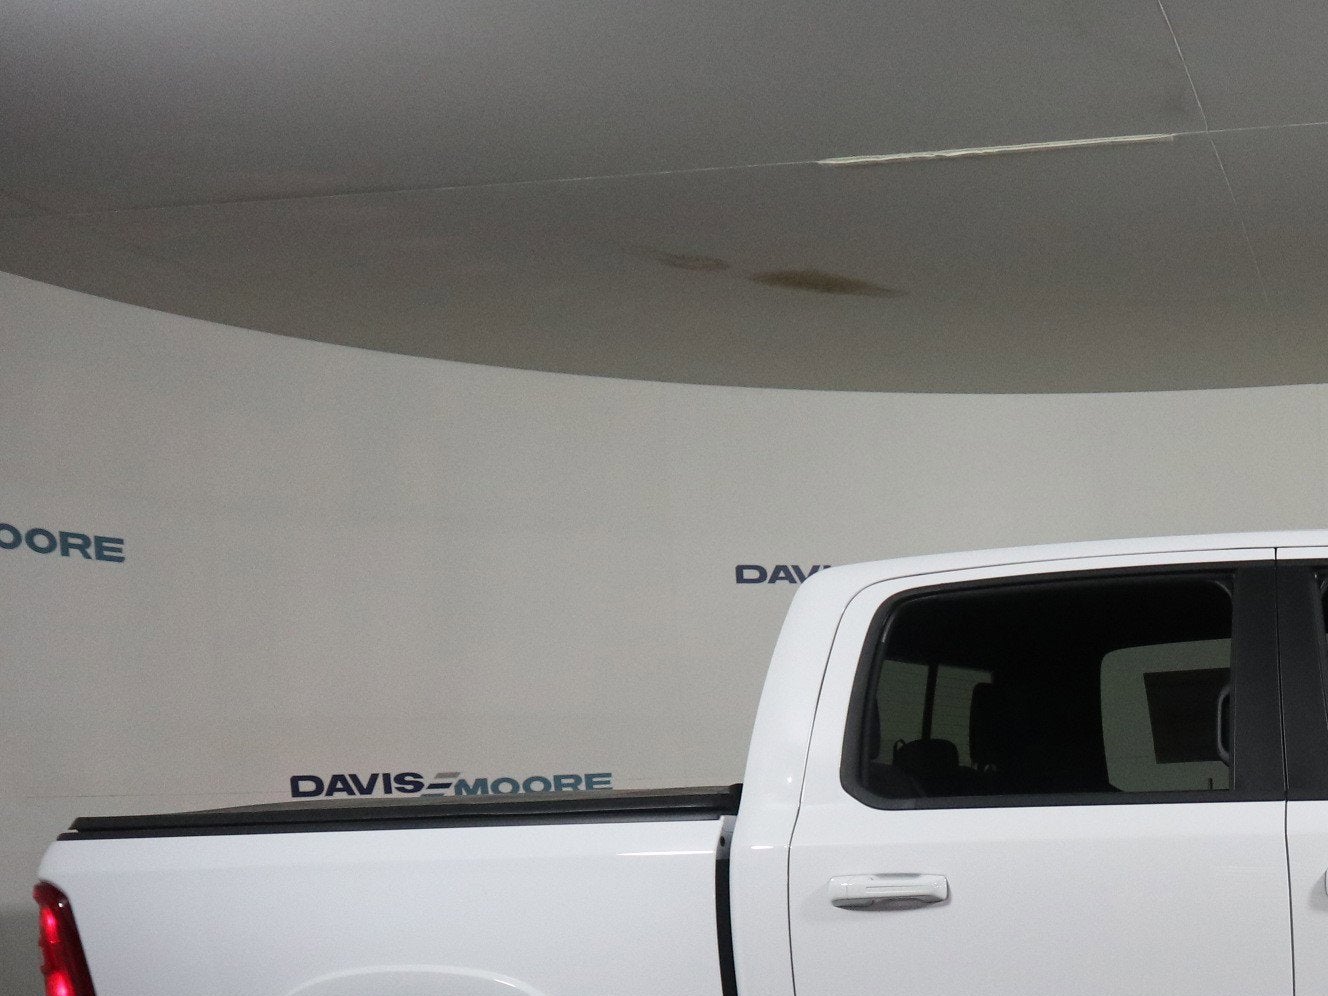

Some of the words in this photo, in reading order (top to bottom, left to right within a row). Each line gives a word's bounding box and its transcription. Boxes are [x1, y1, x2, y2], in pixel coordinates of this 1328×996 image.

[735, 564, 832, 584] DAV
[290, 772, 425, 798] DAVIS
[453, 772, 613, 797] MOORE
